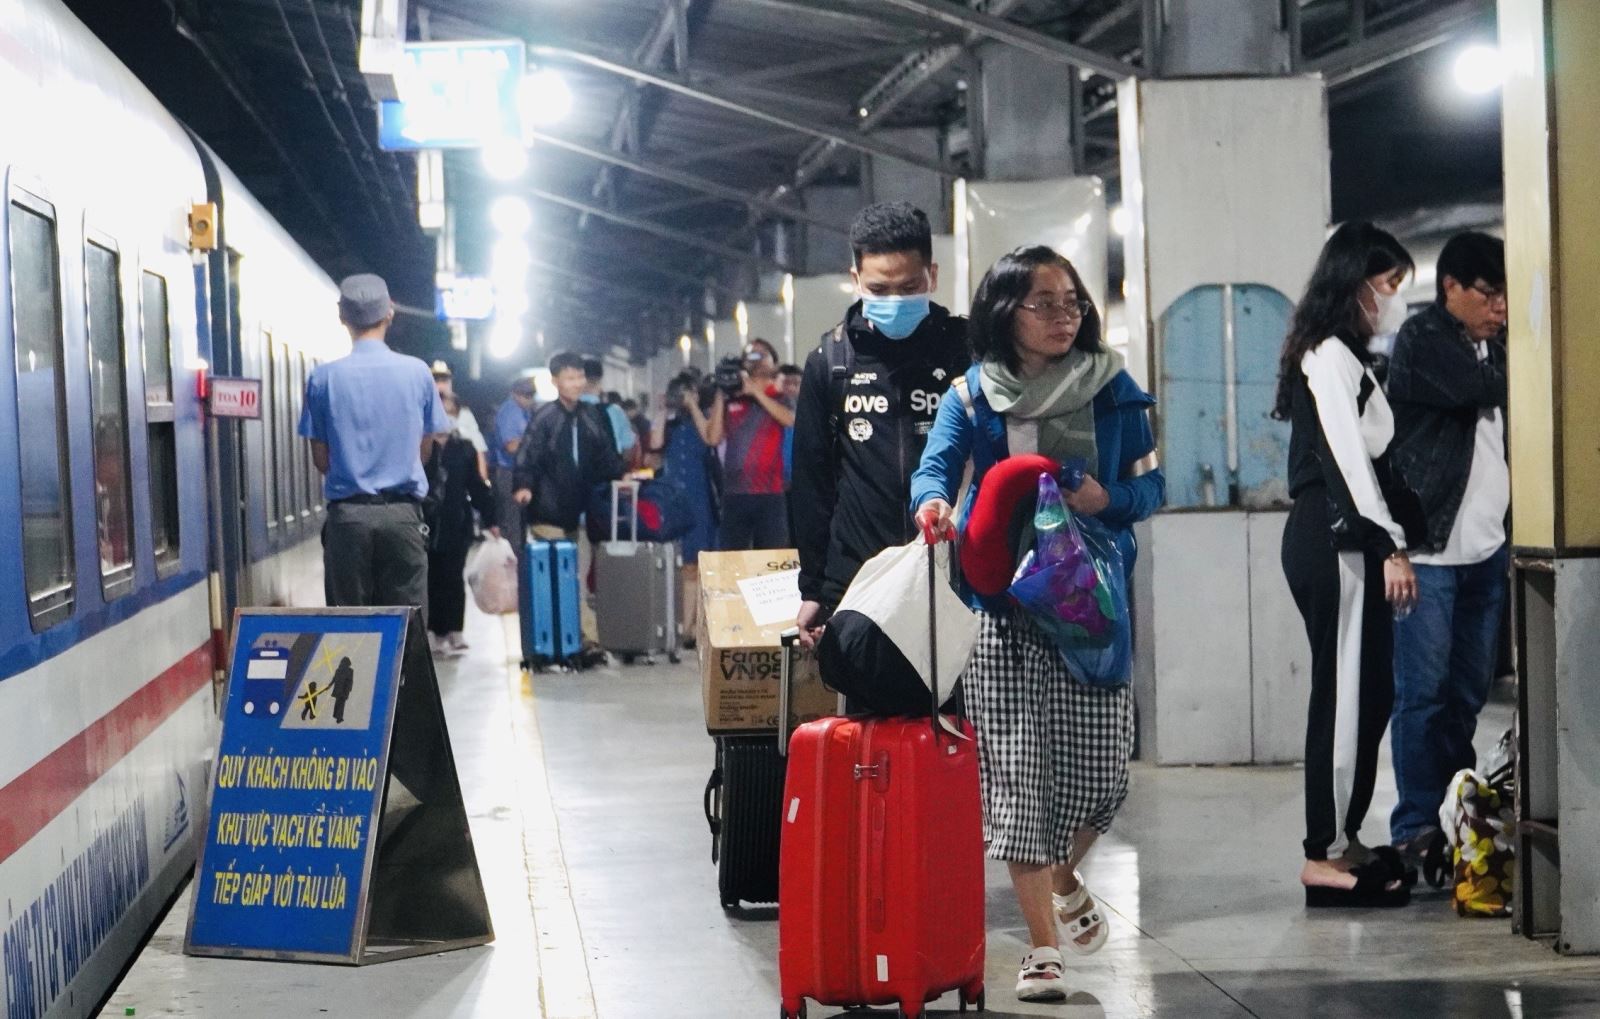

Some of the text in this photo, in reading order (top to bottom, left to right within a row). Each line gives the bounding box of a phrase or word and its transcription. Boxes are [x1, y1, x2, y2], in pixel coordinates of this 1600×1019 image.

[240, 389, 256, 408] 10
[218, 746, 378, 791] QUÝ KHÁCH KHÔNG ĐI VÀO
[216, 812, 244, 846] KHU
[244, 809, 271, 854] VỰC
[271, 814, 307, 854] VẠCH
[327, 806, 362, 850] VÀNG
[213, 858, 240, 905] TIẾP
[241, 864, 272, 906] GIÁP
[296, 866, 322, 909] TÀU
[320, 863, 347, 910] LỬA
[30, 896, 48, 1019] TY
[43, 883, 60, 1004] CP
